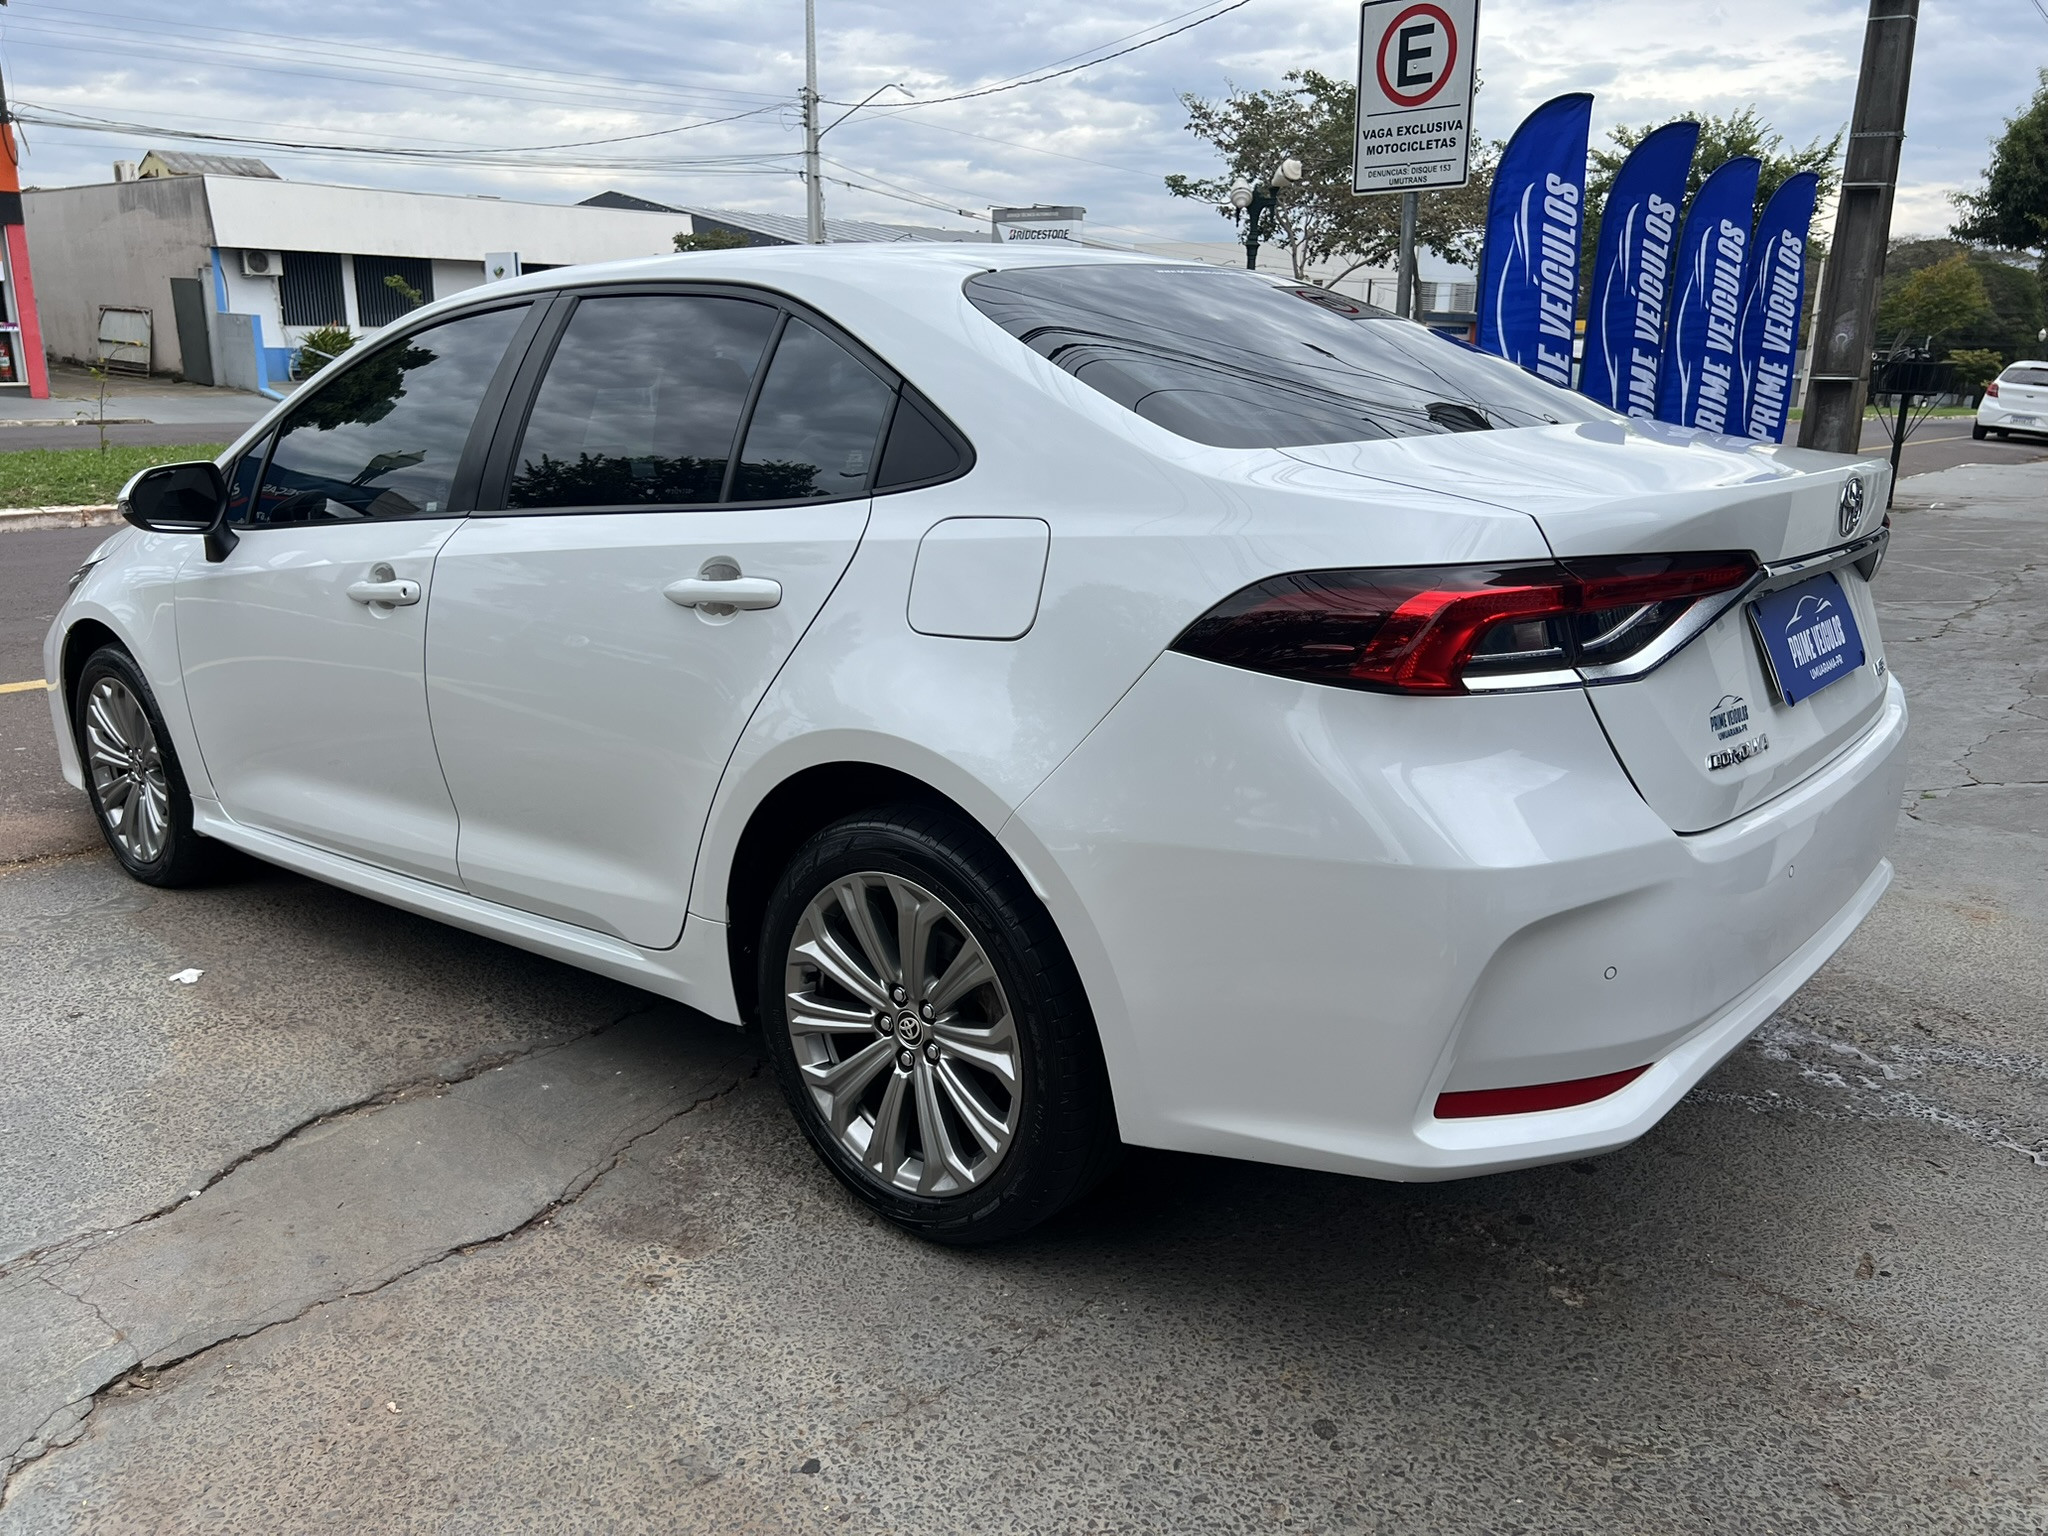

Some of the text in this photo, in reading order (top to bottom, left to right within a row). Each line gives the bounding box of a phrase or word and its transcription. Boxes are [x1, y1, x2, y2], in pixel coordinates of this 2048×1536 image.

[1397, 23, 1435, 88] E
[1362, 119, 1463, 141] VAGA EXCLUSIVA
[1366, 137, 1457, 156] MOTOCICLETAS
[1367, 164, 1451, 179] DENUNCIAS: DISQUE 153
[1388, 175, 1428, 186] UMUTRANS
[1008, 229, 1069, 240] BRIDGESTONE
[1532, 172, 1579, 341] VEÍCULOS
[1631, 193, 1676, 345] VEÍCULOS
[1694, 218, 1745, 434] RIME VEÍCULOS
[1748, 228, 1803, 443] PRIME VEÍCULOS
[1787, 614, 1846, 669] PRIME VEÍCULOS
[1710, 712, 1727, 732] PRIME
